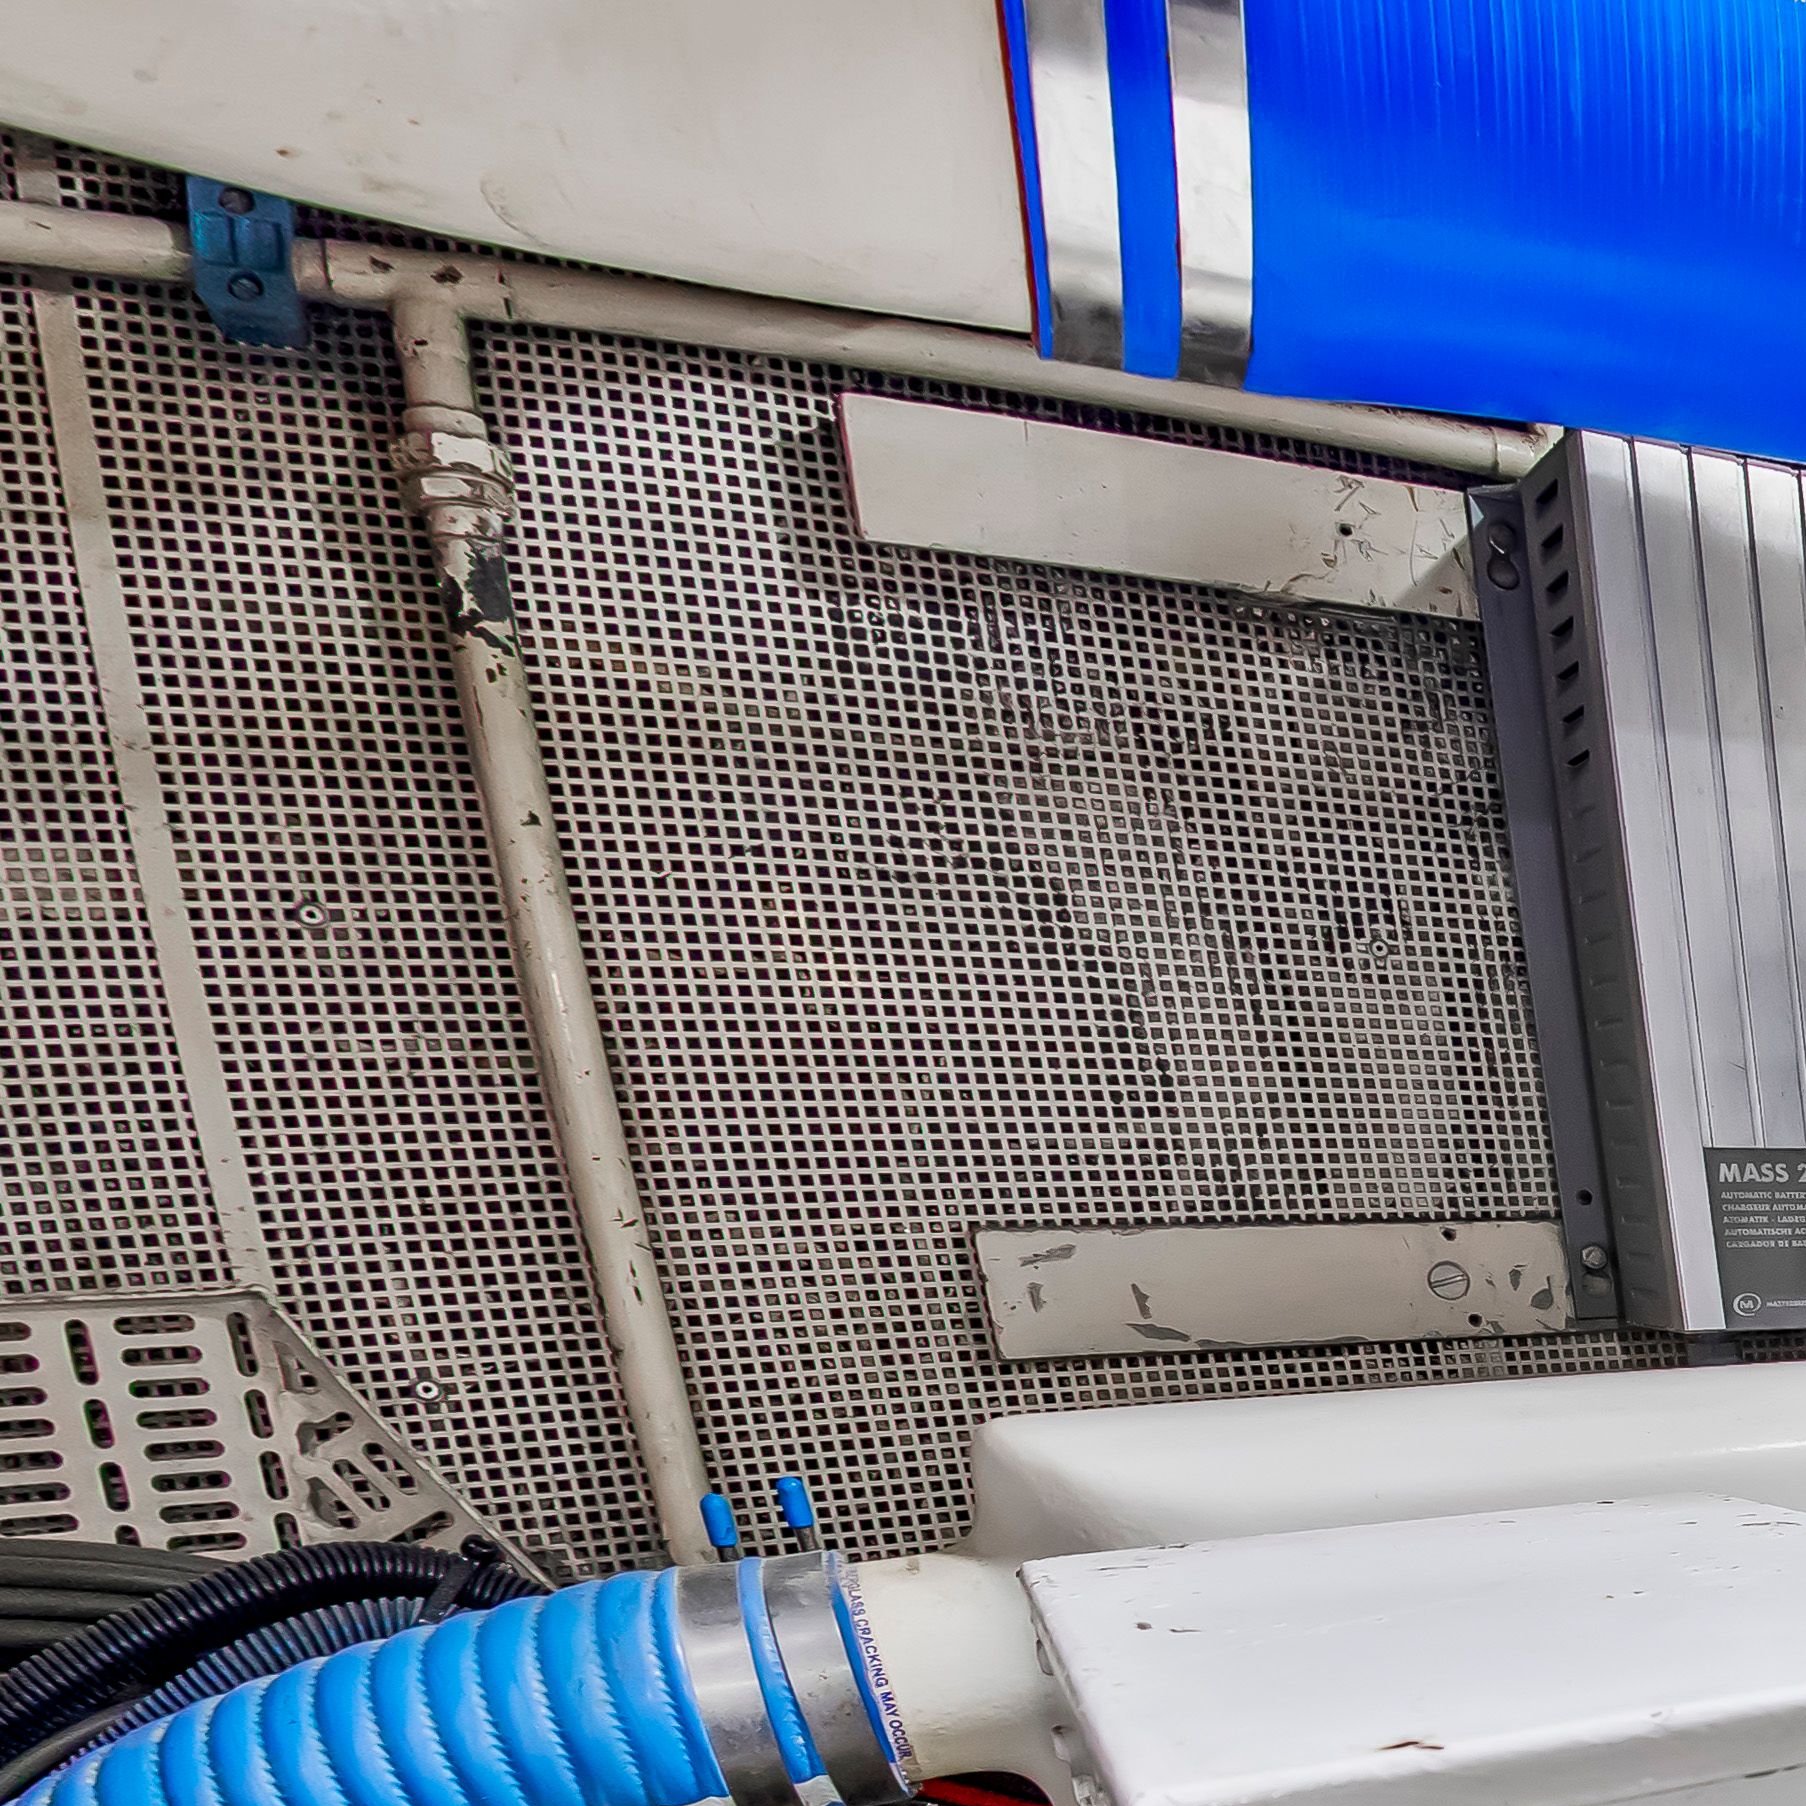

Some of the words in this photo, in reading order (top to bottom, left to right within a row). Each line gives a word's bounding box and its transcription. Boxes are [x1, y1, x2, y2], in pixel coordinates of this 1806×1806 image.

[1719, 1163, 1789, 1183] MASS
[1720, 1191, 1773, 1199] AUTOMATIC
[855, 1617, 889, 1689] CRACKING
[879, 1691, 900, 1717] MAY
[888, 1719, 913, 1760] OCCUR
